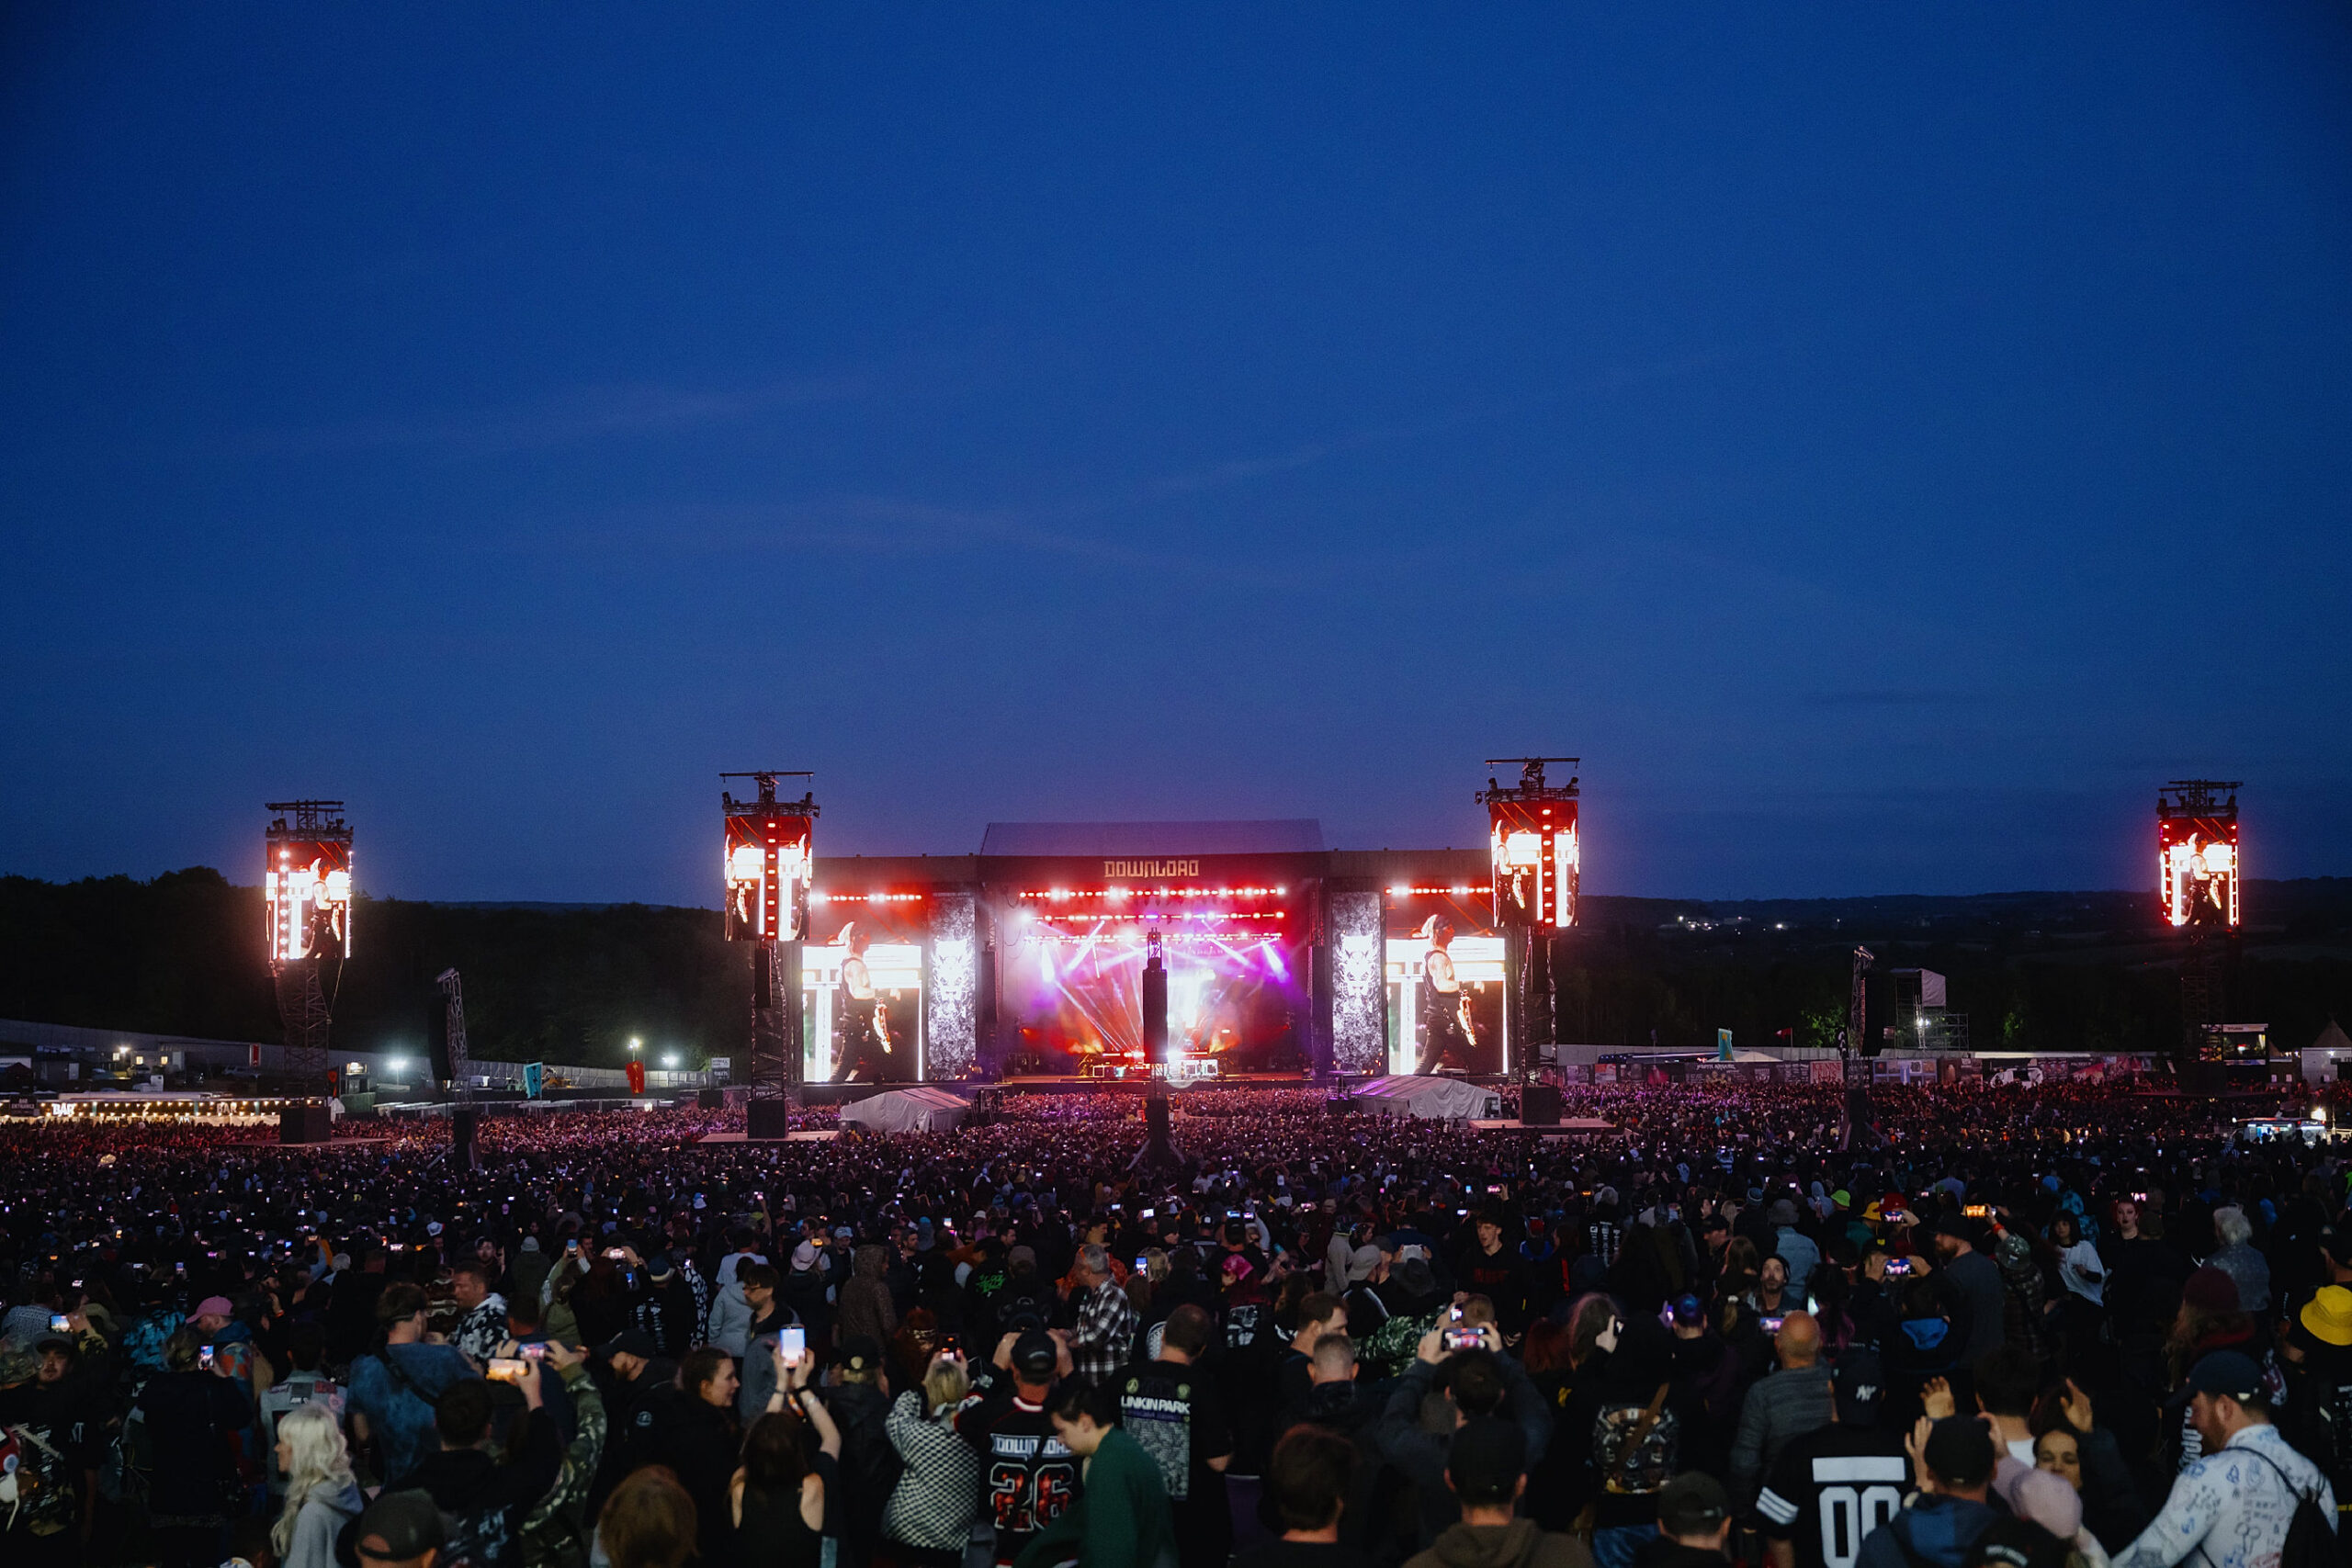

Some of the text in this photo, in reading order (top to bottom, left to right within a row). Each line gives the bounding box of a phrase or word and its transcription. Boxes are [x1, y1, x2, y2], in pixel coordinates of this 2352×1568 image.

[1103, 860, 1199, 878] DOWNLOAD
[51, 1102, 75, 1118] BAR
[217, 1102, 237, 1114] BAR
[1120, 1394, 1158, 1412] LINKIN
[1159, 1398, 1192, 1416] PARK
[989, 1461, 1075, 1532] 26
